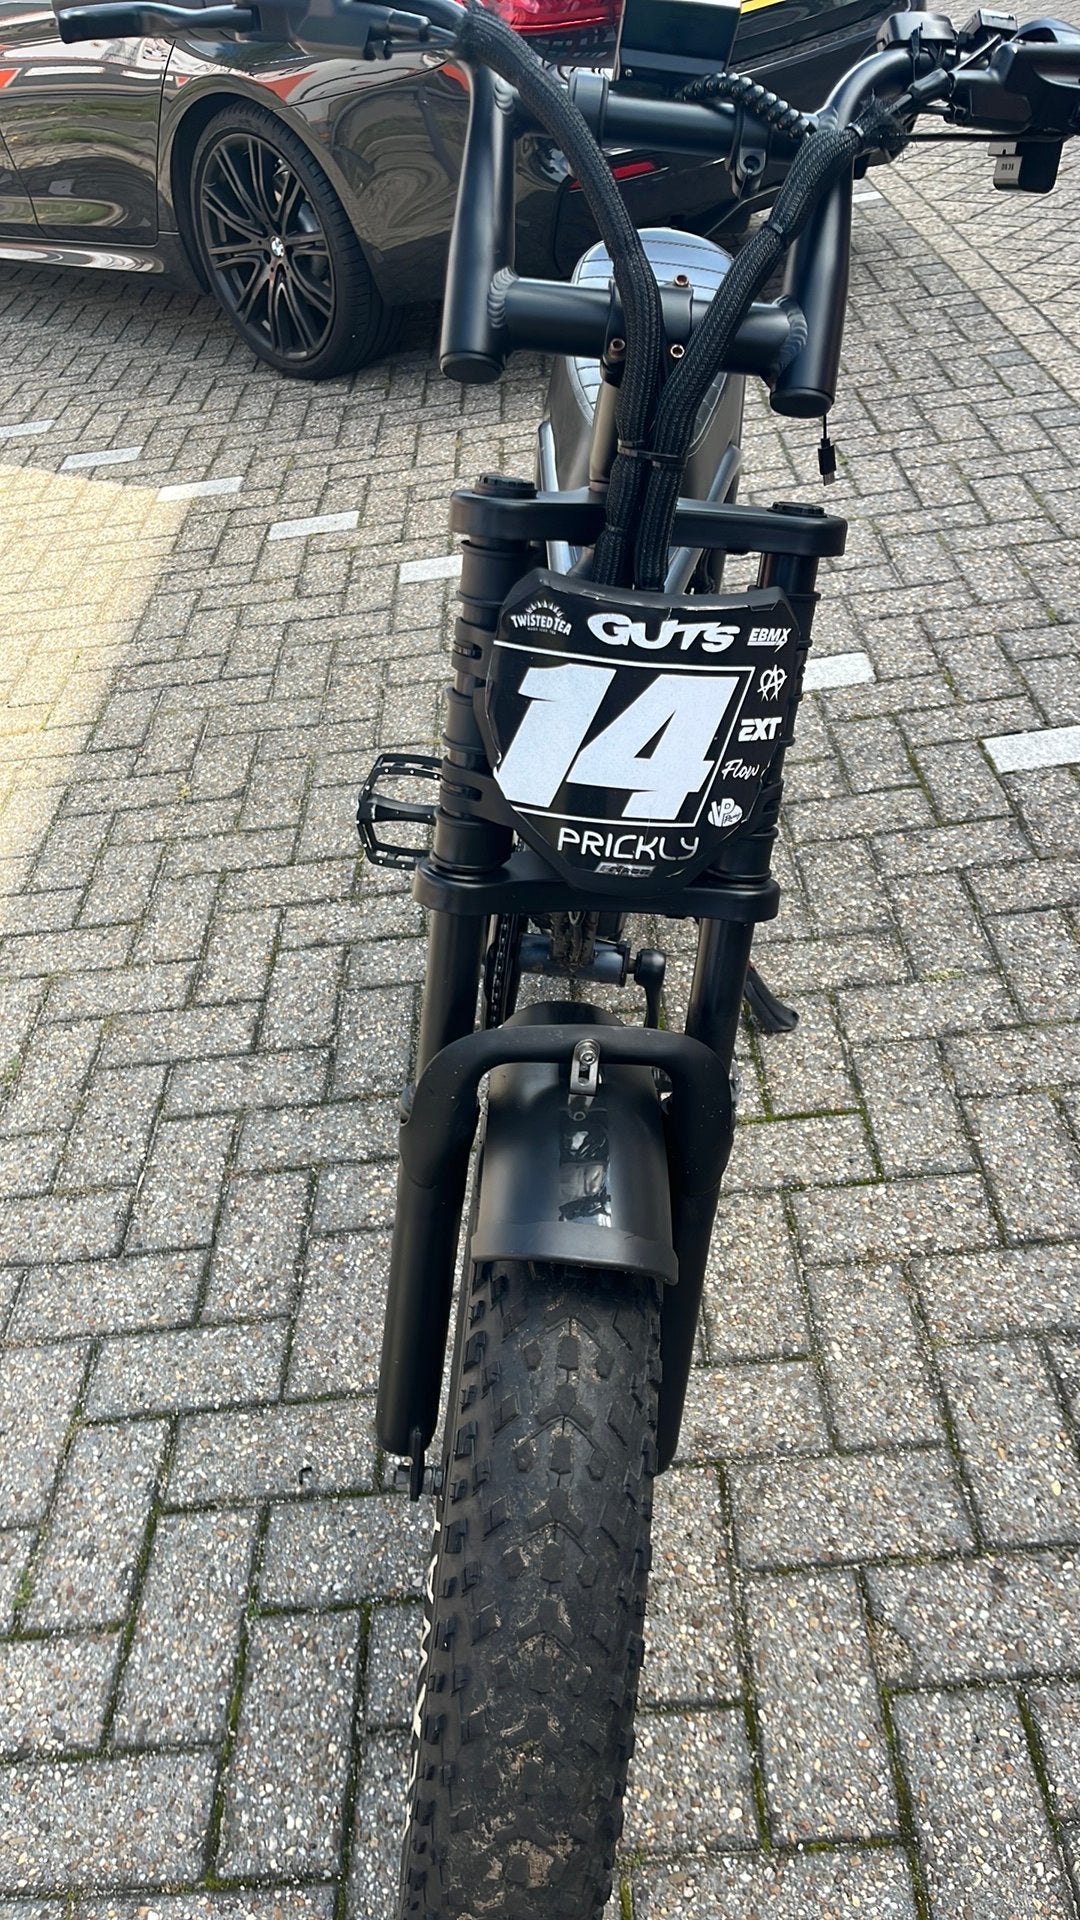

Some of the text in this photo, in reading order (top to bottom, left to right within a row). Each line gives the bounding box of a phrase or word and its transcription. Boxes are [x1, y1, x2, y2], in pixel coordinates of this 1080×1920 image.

[510, 614, 554, 629] TWISTED
[553, 616, 573, 636] TEA
[587, 613, 741, 652] GUTS
[749, 627, 792, 652] EBMX
[493, 663, 740, 820] 14
[738, 717, 782, 742] EXT
[721, 758, 760, 781] Flow
[711, 798, 735, 827] VP
[557, 828, 699, 860] PRICKLY
